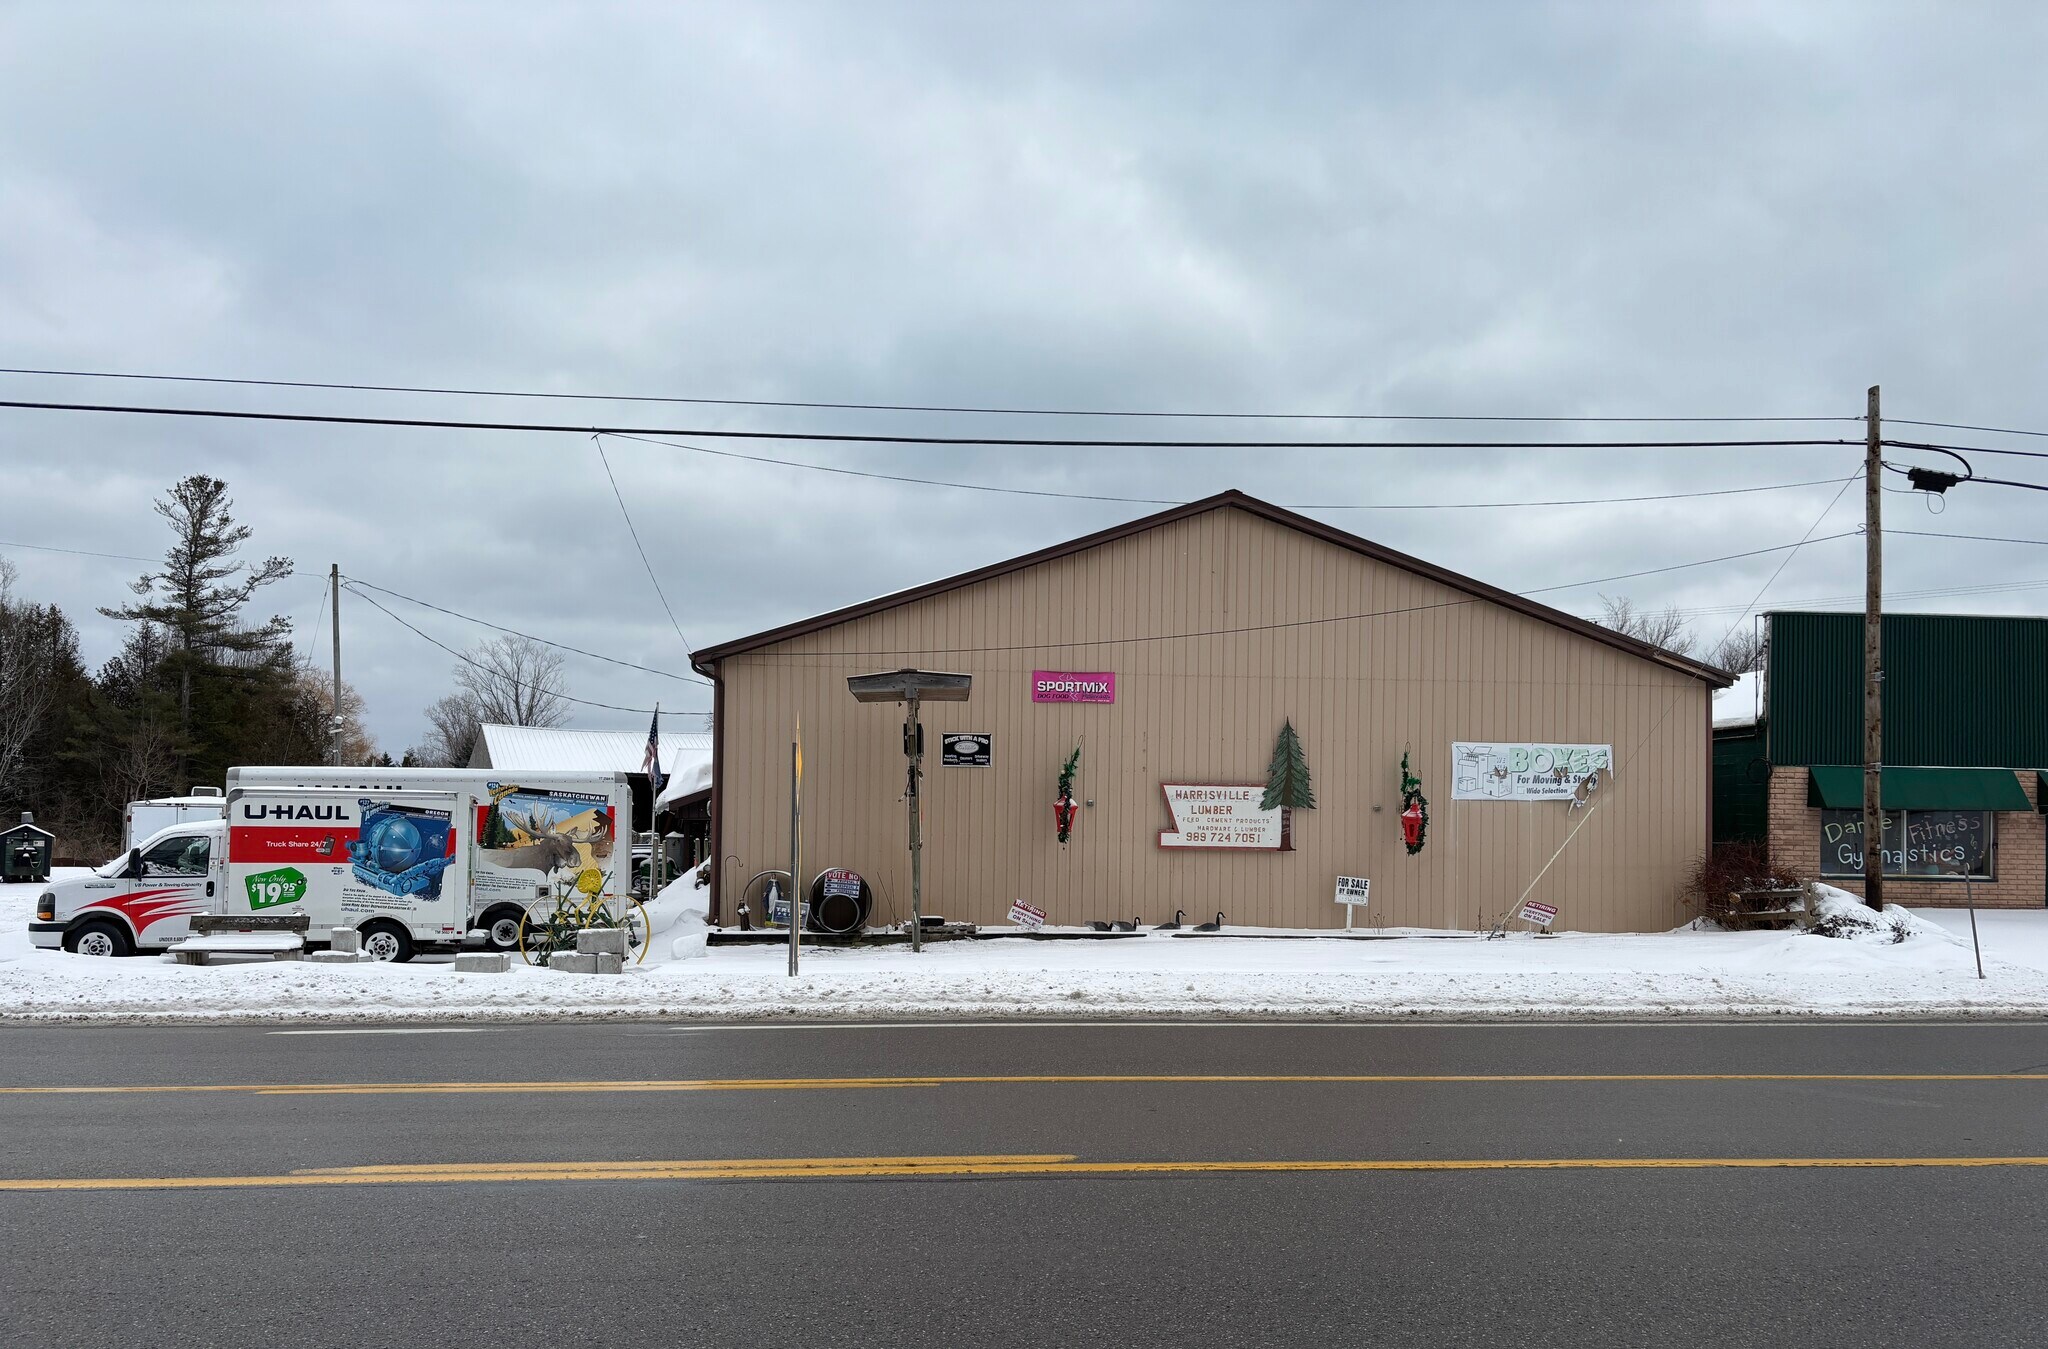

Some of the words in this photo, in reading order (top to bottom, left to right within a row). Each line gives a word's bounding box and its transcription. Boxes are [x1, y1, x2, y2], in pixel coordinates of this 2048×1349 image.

[1517, 775, 1530, 784] For
[1532, 775, 1562, 786] Moving
[1565, 775, 1570, 784] &
[549, 791, 605, 801] SASKATCHEWAN
[1175, 790, 1250, 800] HARRISVILLE
[1191, 805, 1233, 815] LUMBER
[1824, 817, 1892, 843] Dane
[1908, 816, 1981, 844] Fitness
[1186, 832, 1207, 842] 989
[1210, 833, 1231, 843] 724
[1235, 833, 1261, 843] 7051
[1837, 844, 1966, 870] Gynastics
[1338, 878, 1349, 887] FOR
[1351, 879, 1368, 889] SALE
[1015, 900, 1045, 916] RETIRING
[1528, 902, 1556, 912] RETIRING
[1012, 909, 1041, 923] EVERYTHING
[1524, 909, 1551, 919] EVERYTHING
[1532, 915, 1546, 923] SALE
[1022, 918, 1036, 926] SALE
